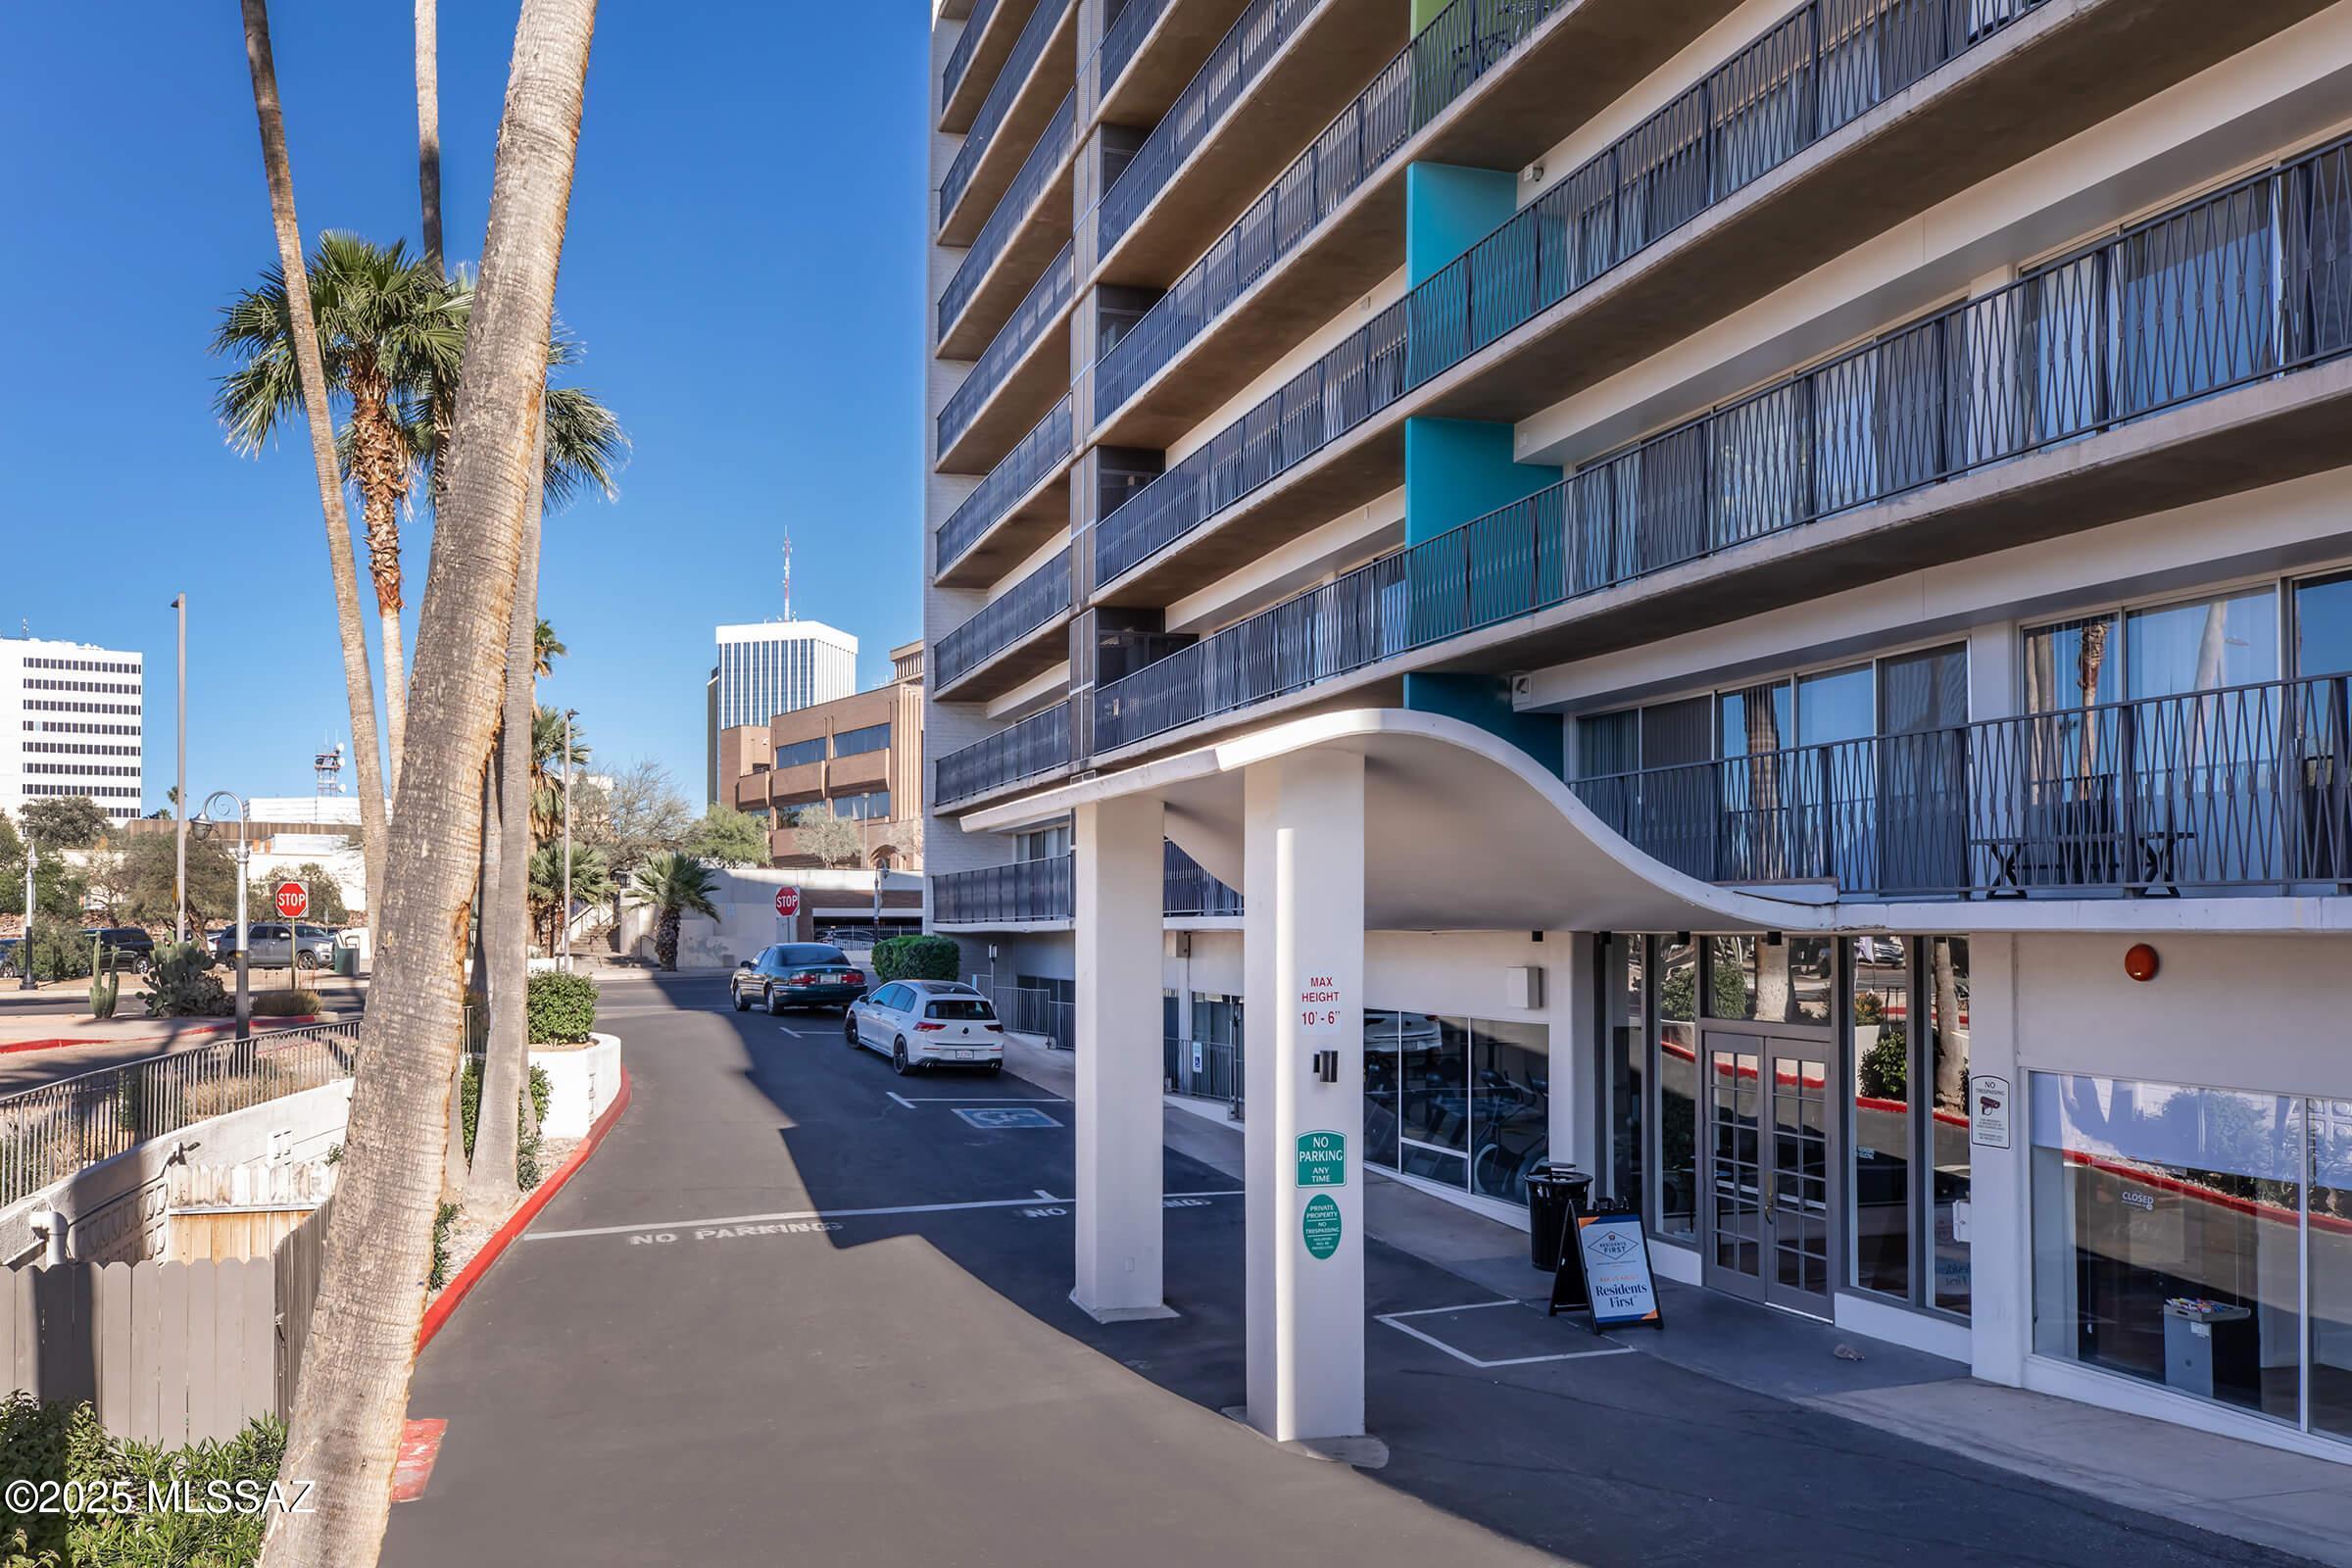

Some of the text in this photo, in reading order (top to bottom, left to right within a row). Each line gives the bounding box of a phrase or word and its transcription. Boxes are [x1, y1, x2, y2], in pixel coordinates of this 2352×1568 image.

[278, 893, 306, 906] STOP
[776, 895, 798, 908] STOP
[1310, 977, 1333, 987] MAX
[1301, 991, 1340, 1003] HEIGHT
[1313, 1136, 1329, 1148] NO
[1298, 1150, 1343, 1162] PARKING
[2122, 1191, 2154, 1204] CLOSED
[1023, 1207, 1067, 1217] NO
[629, 1222, 844, 1246] NO PARKING
[1595, 1283, 1647, 1297] Residents
[1609, 1296, 1635, 1308] First
